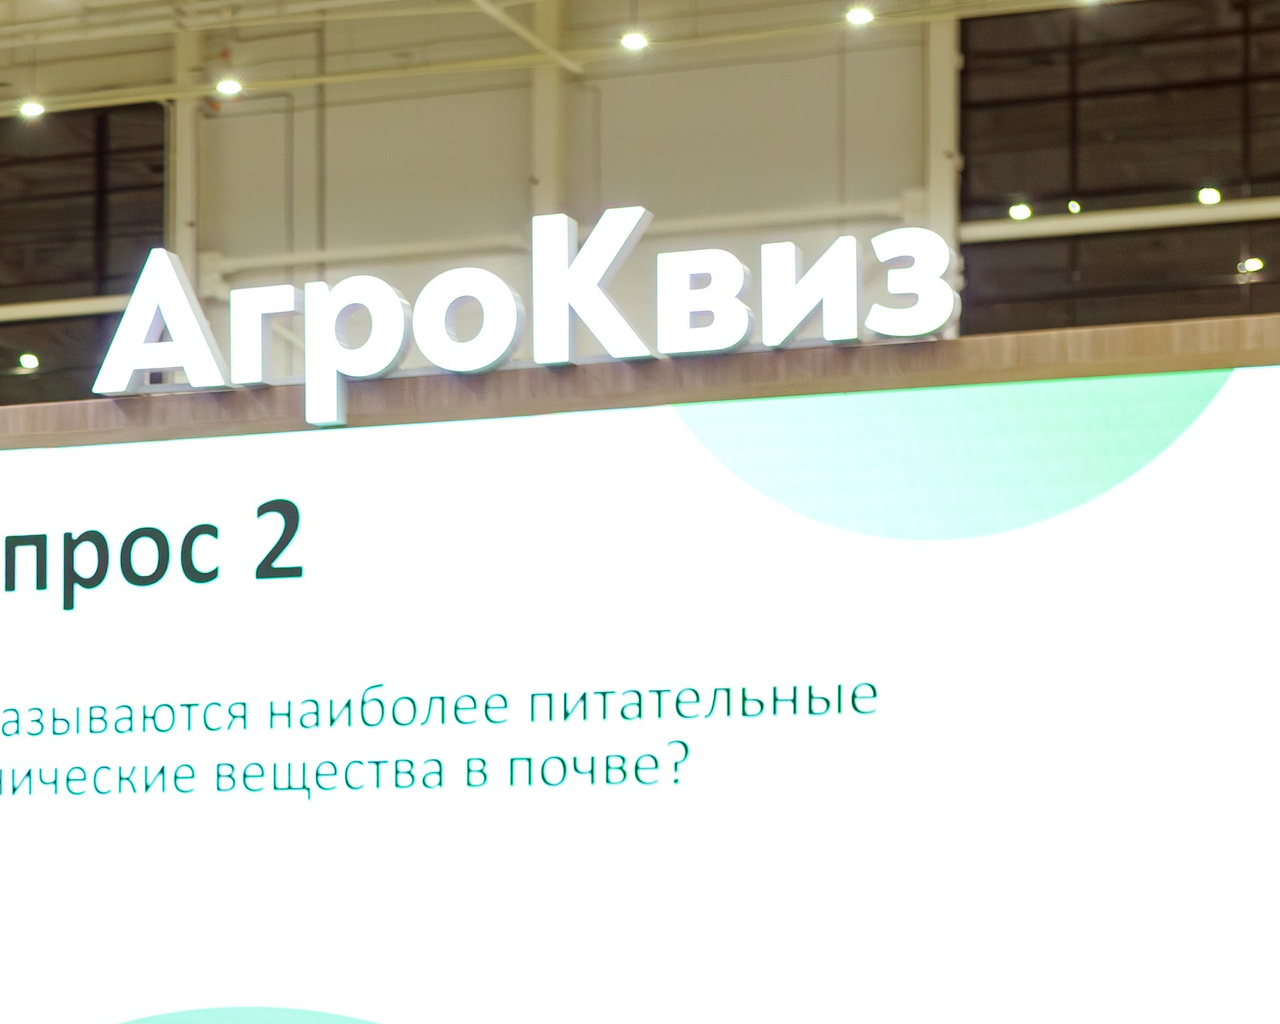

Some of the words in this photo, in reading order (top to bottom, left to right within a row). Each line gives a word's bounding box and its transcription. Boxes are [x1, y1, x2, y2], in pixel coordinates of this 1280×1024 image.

[92, 205, 962, 426] АгроКвиз
[255, 498, 304, 580] 2
[269, 683, 509, 731] наиболее
[530, 682, 879, 723] питательные
[216, 758, 444, 801] вещества
[466, 757, 489, 788] в
[509, 739, 691, 787] почве?
